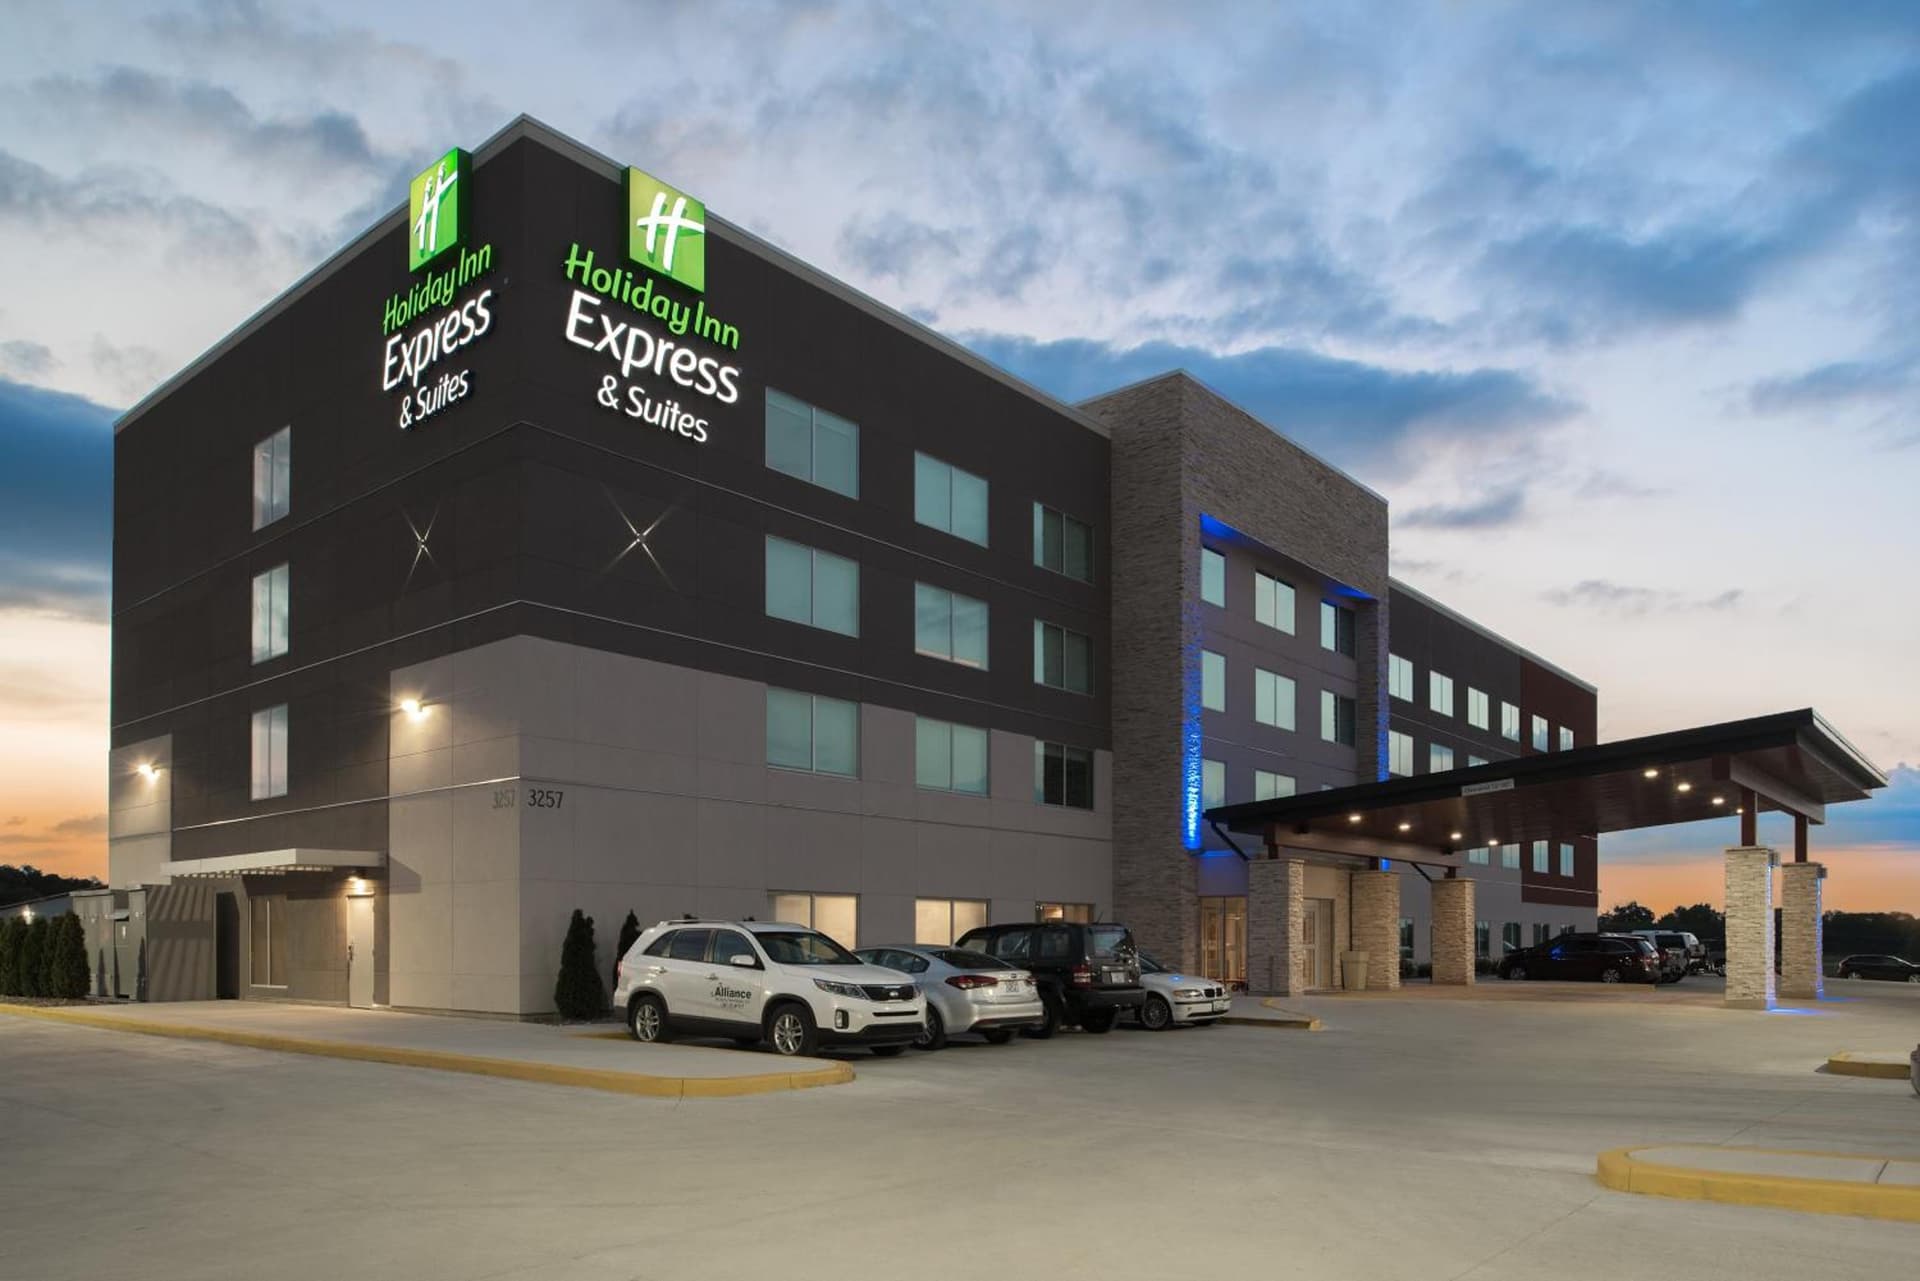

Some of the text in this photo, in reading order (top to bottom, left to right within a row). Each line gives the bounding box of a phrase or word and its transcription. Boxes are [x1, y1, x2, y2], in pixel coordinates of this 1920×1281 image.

[384, 244, 491, 336] Holiday Inn
[564, 243, 740, 350] Holiday Inn
[383, 290, 492, 391] Express
[565, 289, 740, 404] Express
[400, 369, 469, 429] & Suites
[597, 375, 709, 442] & Suites
[527, 788, 564, 809] 3257
[714, 986, 752, 1000] Alliance
